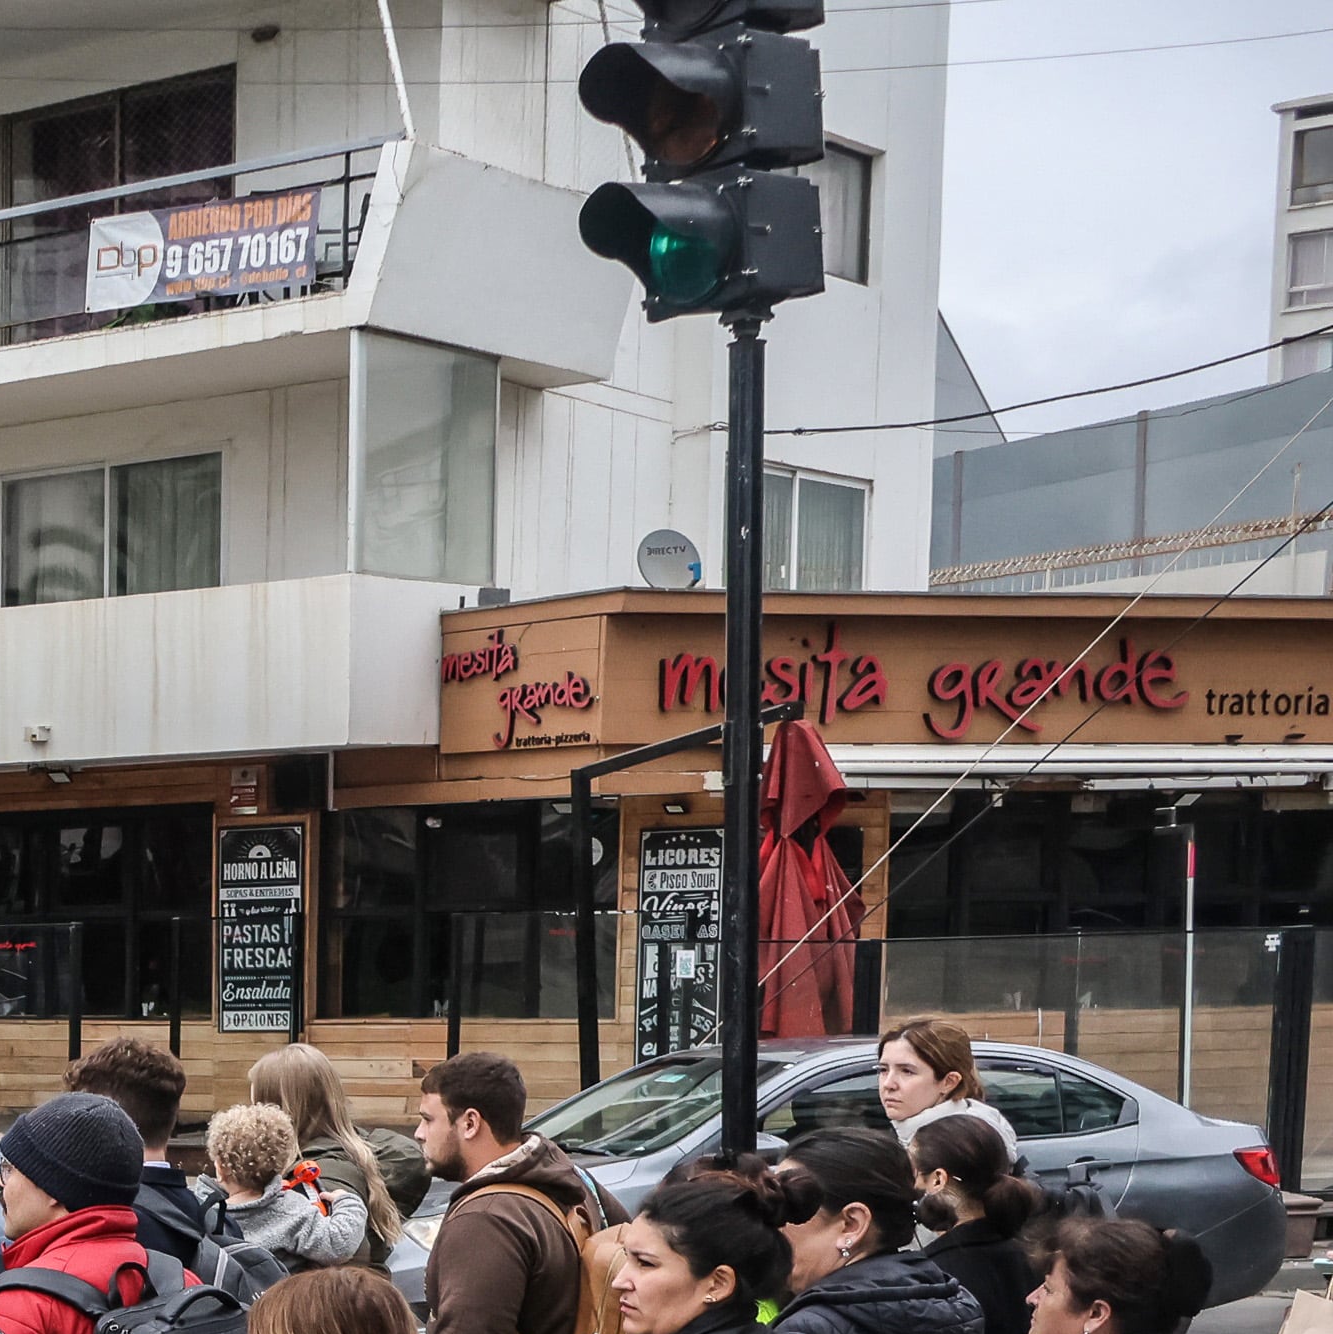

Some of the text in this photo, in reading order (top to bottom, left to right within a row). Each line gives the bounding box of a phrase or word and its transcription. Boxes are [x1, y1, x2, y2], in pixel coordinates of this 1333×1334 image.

[168, 203, 241, 240] ARRIENDO
[244, 199, 275, 230] POR
[165, 226, 310, 278] 9 657 70167
[442, 630, 517, 682] mesita
[659, 622, 1330, 738] msita grande trattoria
[493, 672, 592, 749] grande
[223, 857, 297, 880] HORNO A LEÑA
[644, 848, 720, 867] LICORES
[223, 924, 280, 944] PASTAS
